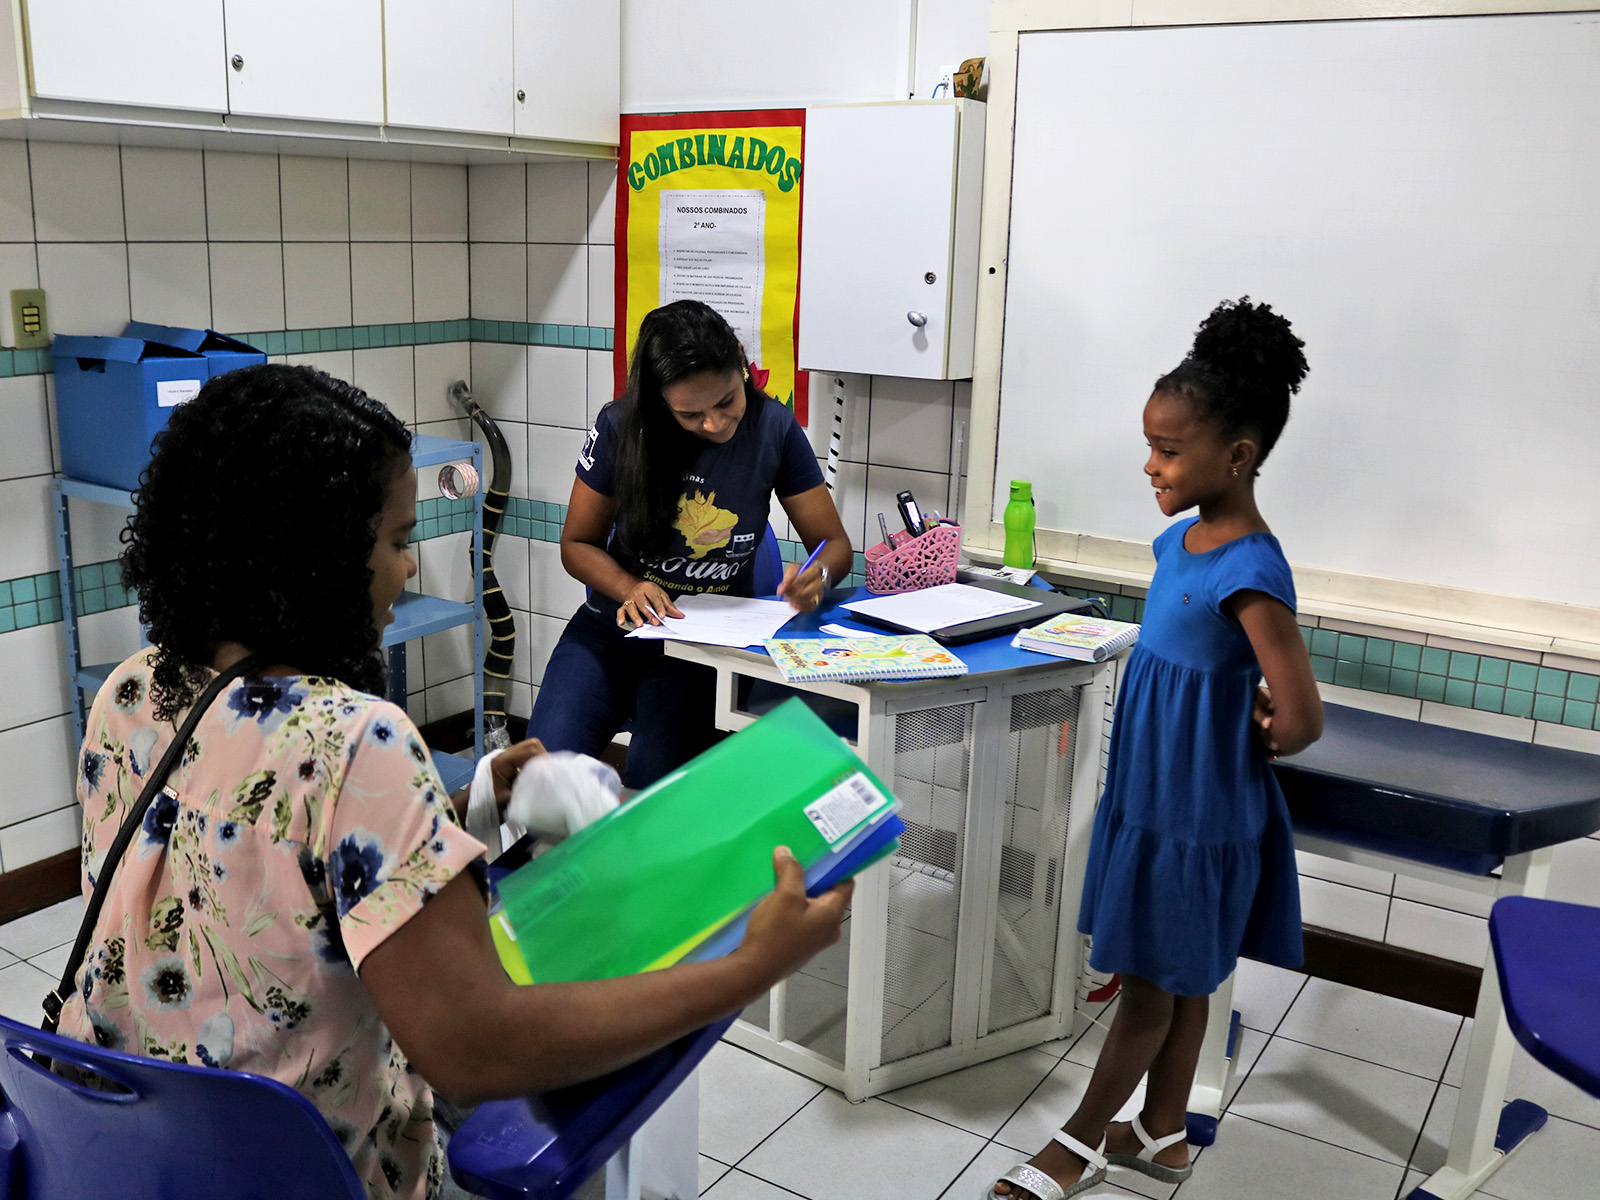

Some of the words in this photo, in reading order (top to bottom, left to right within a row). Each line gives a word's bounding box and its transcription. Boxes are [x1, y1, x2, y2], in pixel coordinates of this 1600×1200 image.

[628, 134, 802, 193] COMBINADOS
[676, 206, 703, 214] NOSSOS
[704, 207, 748, 215] COMBINADOS
[643, 570, 694, 592] Semeando
